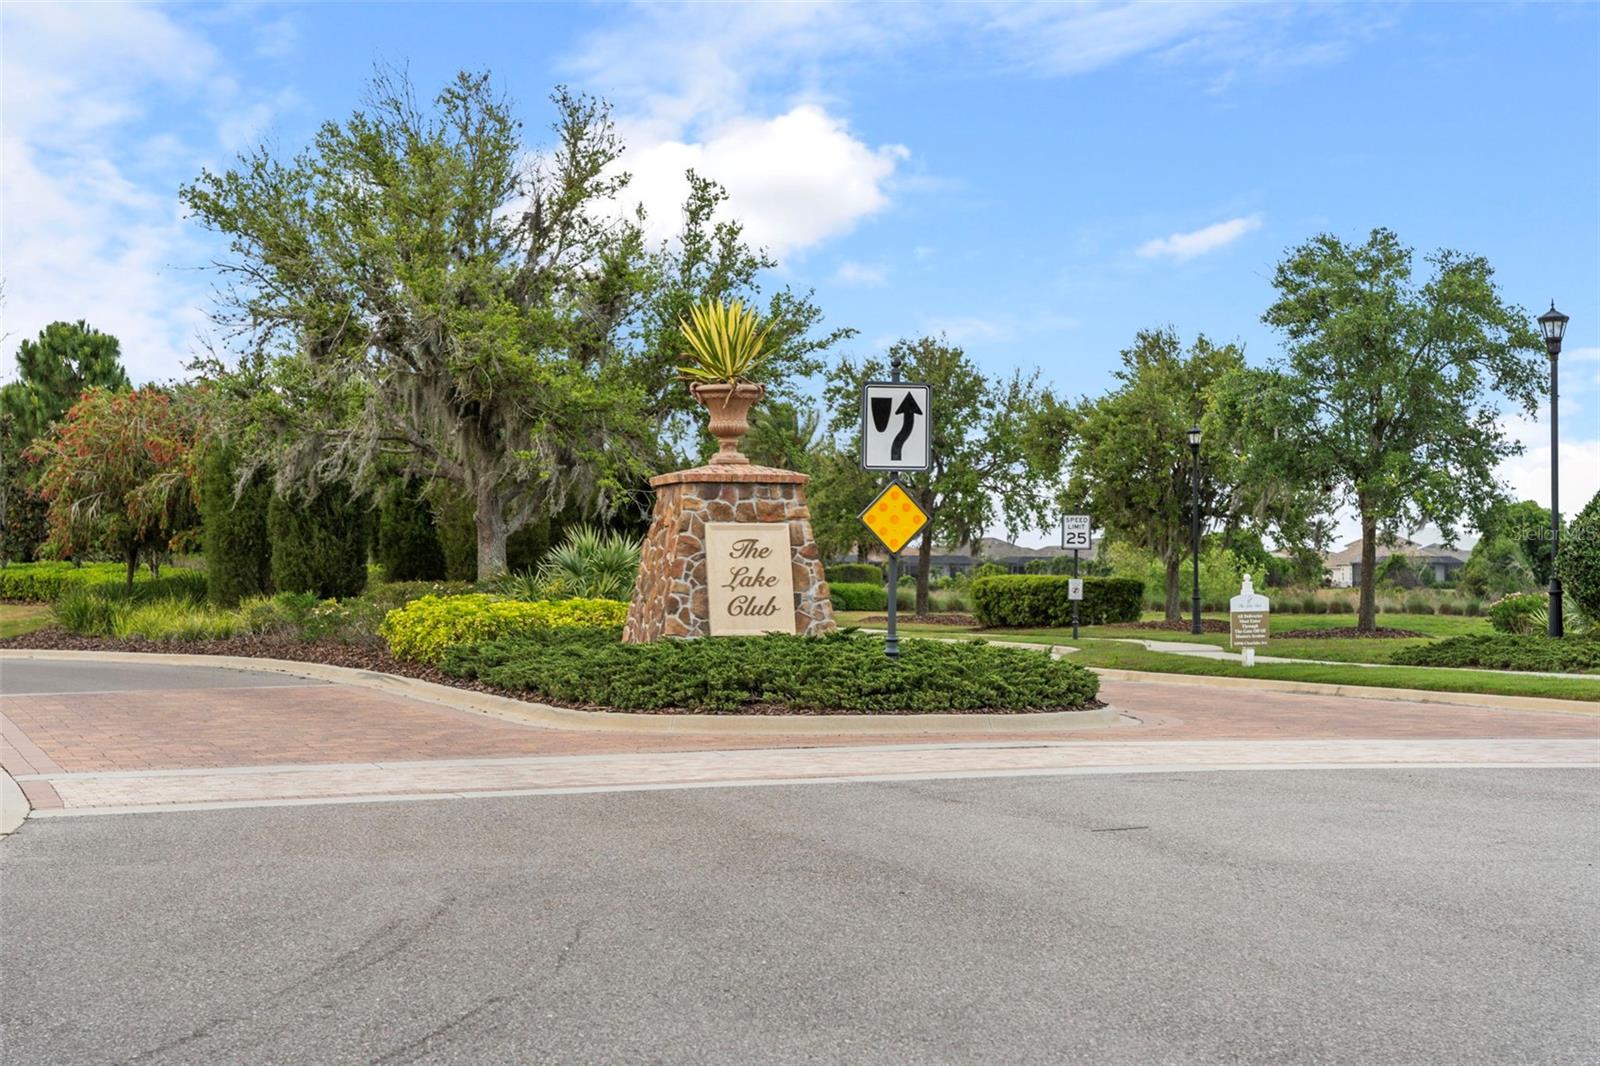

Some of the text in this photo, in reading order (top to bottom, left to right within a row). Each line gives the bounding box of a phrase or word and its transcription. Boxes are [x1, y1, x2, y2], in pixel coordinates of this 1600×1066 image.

[729, 538, 773, 559] The
[1066, 532, 1087, 544] 25
[721, 566, 780, 592] Lake
[727, 595, 781, 616] Club
